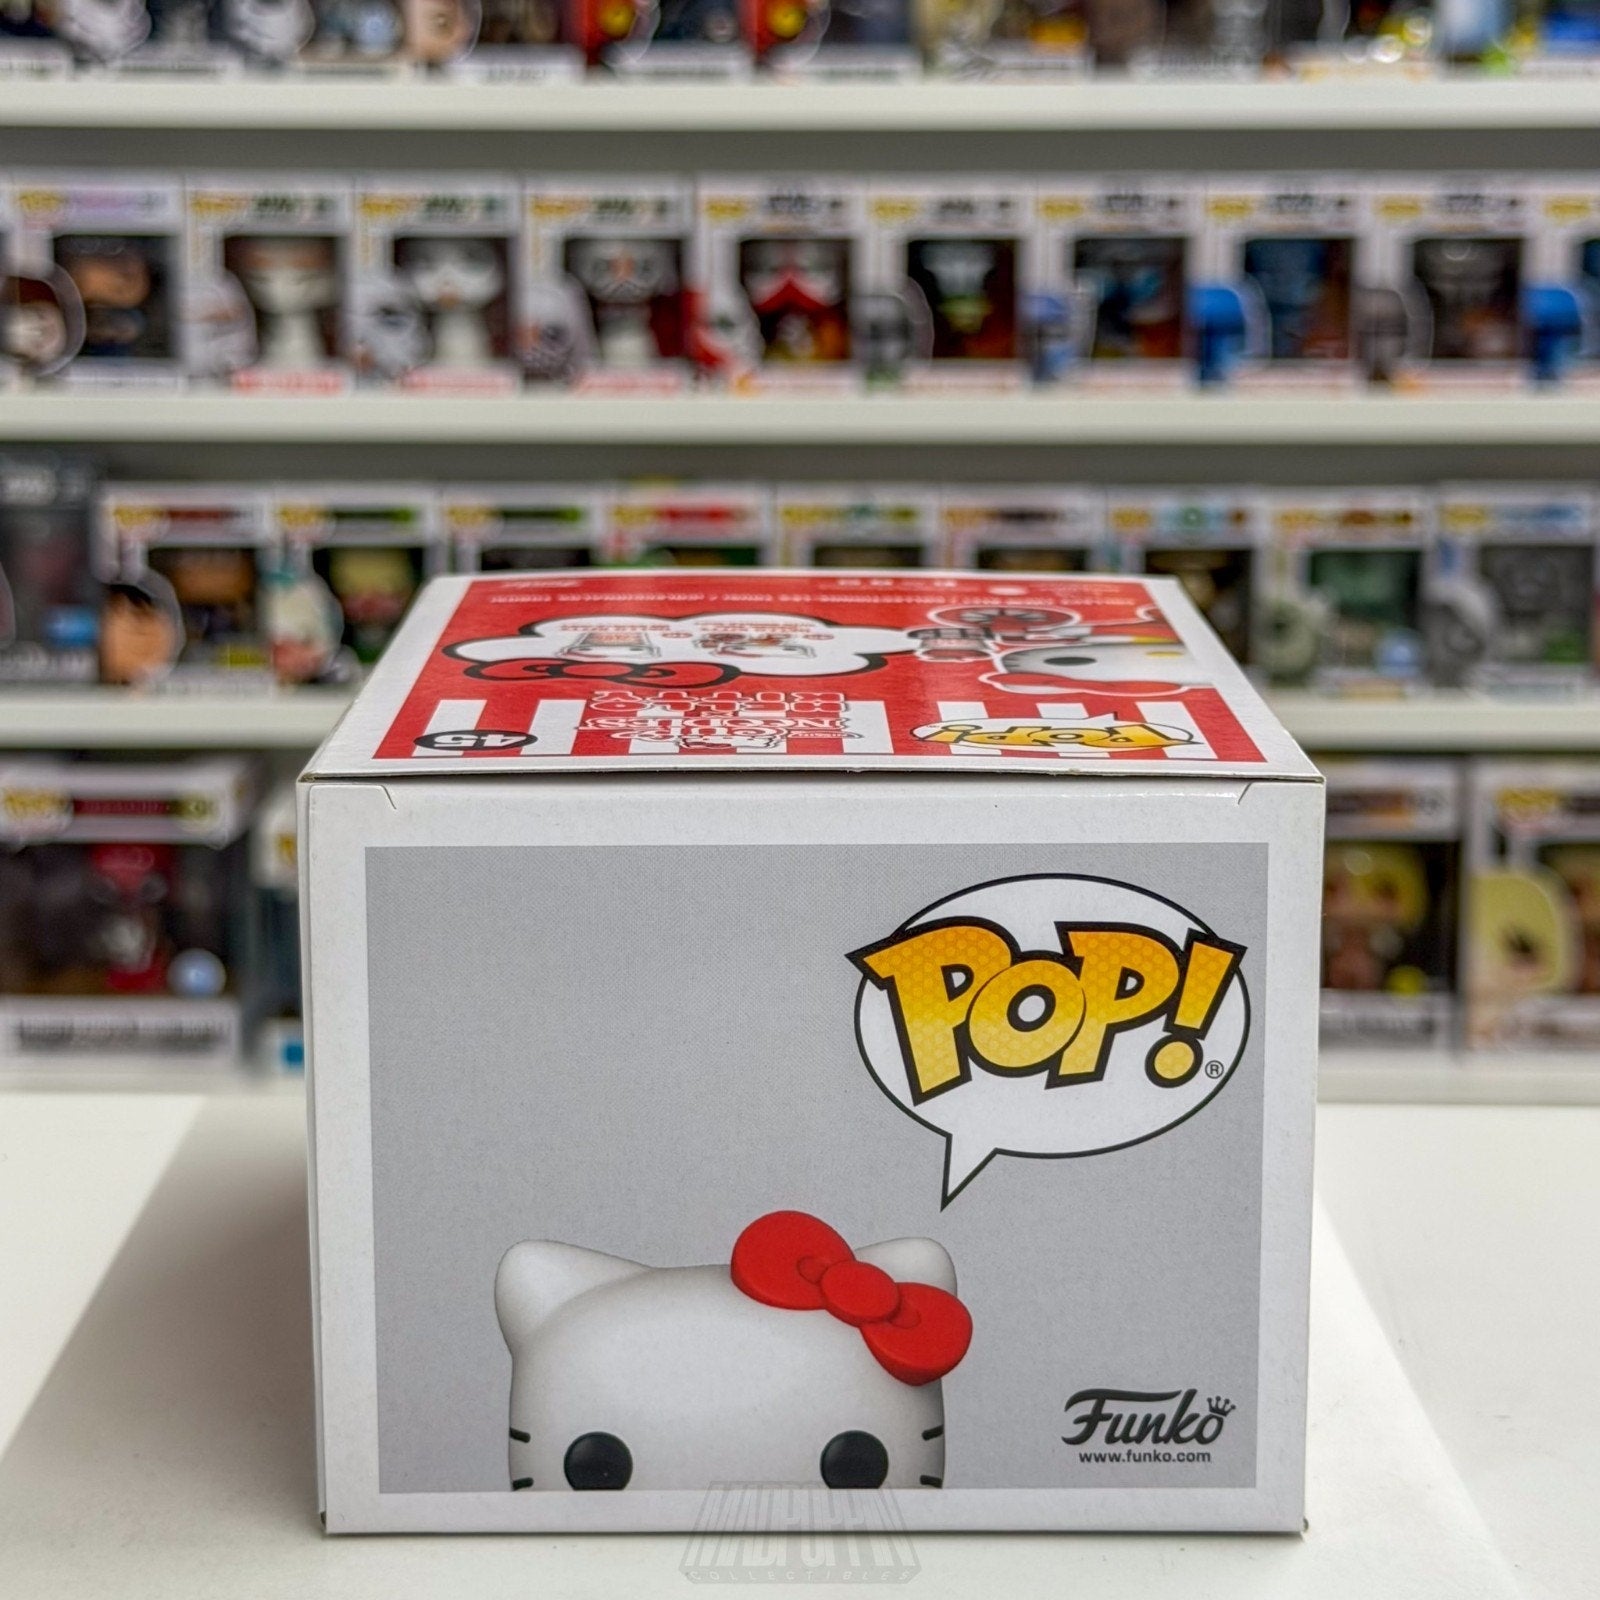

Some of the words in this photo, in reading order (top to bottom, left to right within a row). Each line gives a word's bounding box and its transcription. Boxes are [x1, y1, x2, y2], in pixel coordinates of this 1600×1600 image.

[592, 691, 846, 702] KITTY
[589, 700, 847, 712] HELLO
[596, 717, 839, 729] NOODLES
[433, 733, 528, 748] 45
[915, 723, 1204, 748] POP!
[844, 915, 1248, 1107] POP!
[1061, 1388, 1225, 1446] Funko
[1078, 1449, 1212, 1464] www.funko.com
